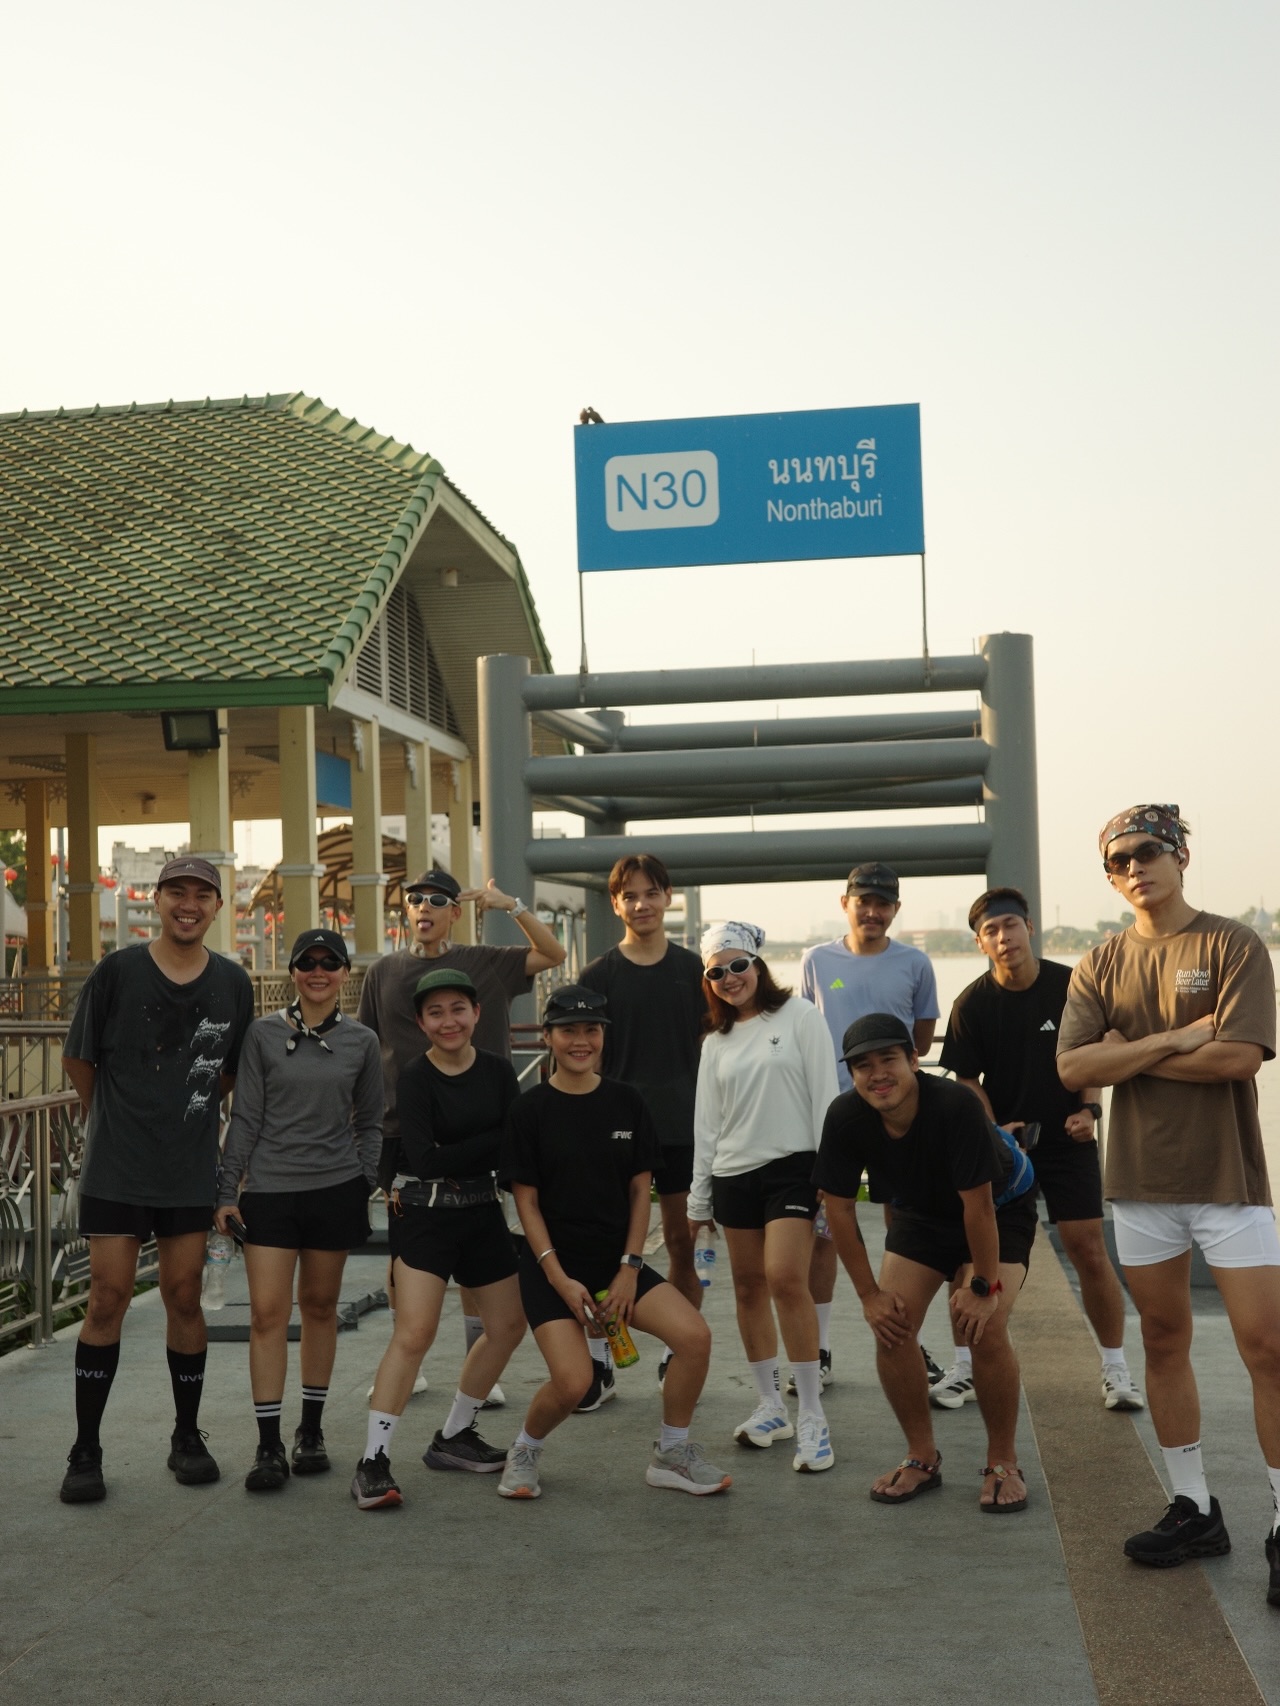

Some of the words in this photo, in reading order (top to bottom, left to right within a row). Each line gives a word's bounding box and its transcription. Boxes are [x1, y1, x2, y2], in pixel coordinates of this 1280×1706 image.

[768, 438, 878, 493] นนทบุรี
[616, 469, 707, 512] N30
[767, 494, 883, 523] Nonthaburi
[1175, 969, 1191, 978] Run
[1191, 968, 1209, 978] Now
[1175, 977, 1191, 986] Beer
[1191, 977, 1210, 986] Later
